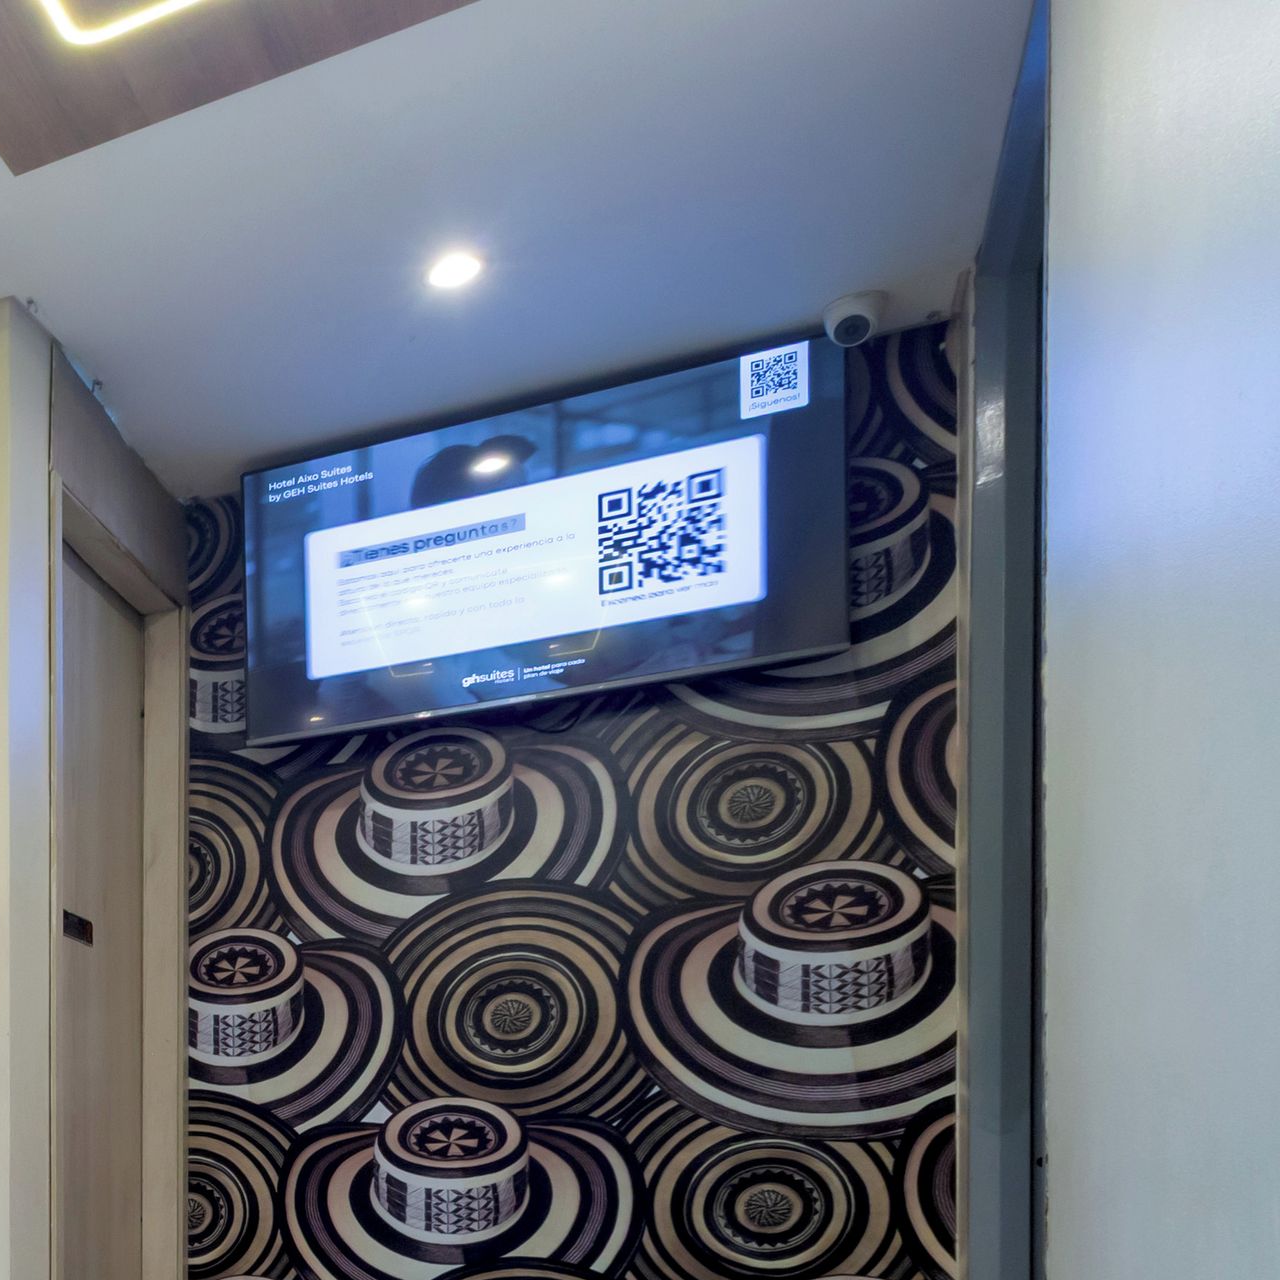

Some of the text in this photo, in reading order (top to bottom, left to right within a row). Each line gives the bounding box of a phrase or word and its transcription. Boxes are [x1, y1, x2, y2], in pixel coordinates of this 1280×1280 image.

[268, 465, 352, 491] Hotel Aixo Suites
[268, 471, 374, 503] by GEH Suites Hotels
[413, 518, 518, 553] preguntas?
[495, 537, 554, 555] experiencia
